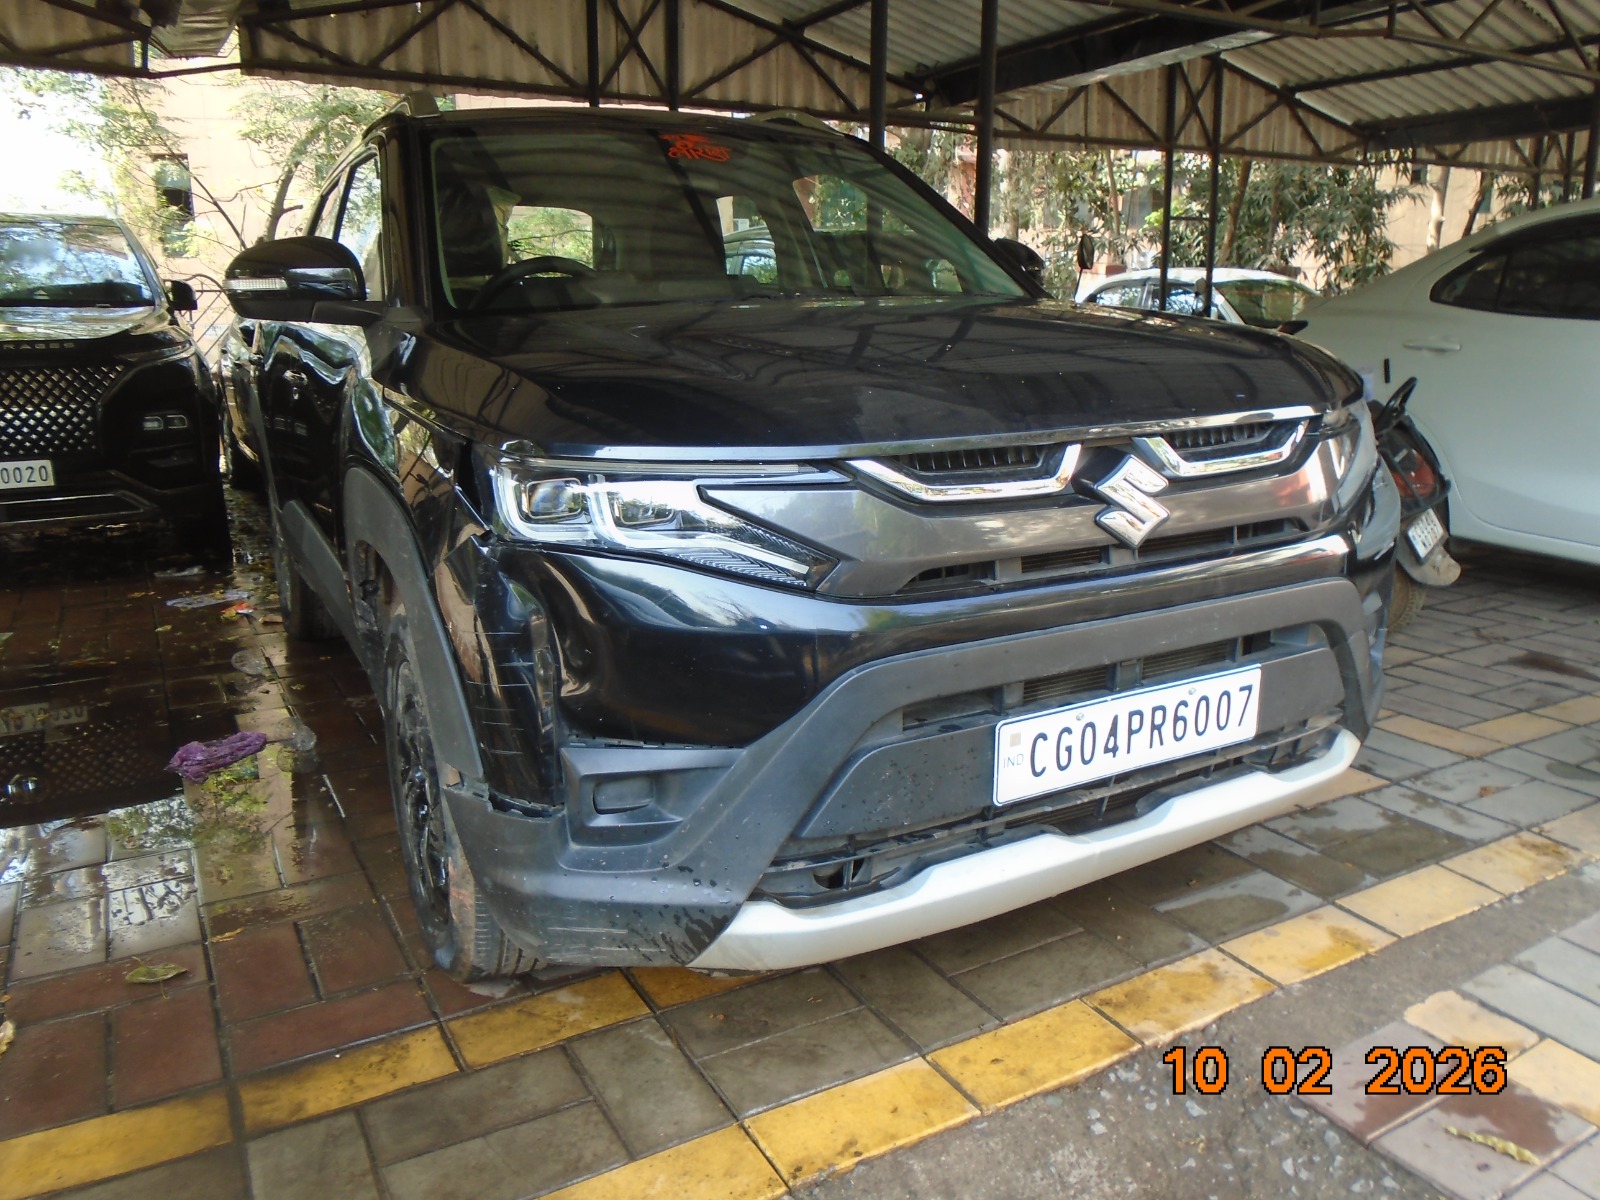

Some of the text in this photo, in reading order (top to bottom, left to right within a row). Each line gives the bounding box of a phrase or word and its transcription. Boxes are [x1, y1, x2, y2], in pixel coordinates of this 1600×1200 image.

[0, 465, 49, 484] 0020
[1029, 683, 1254, 778] CG04PR6007
[1003, 753, 1025, 769] IND
